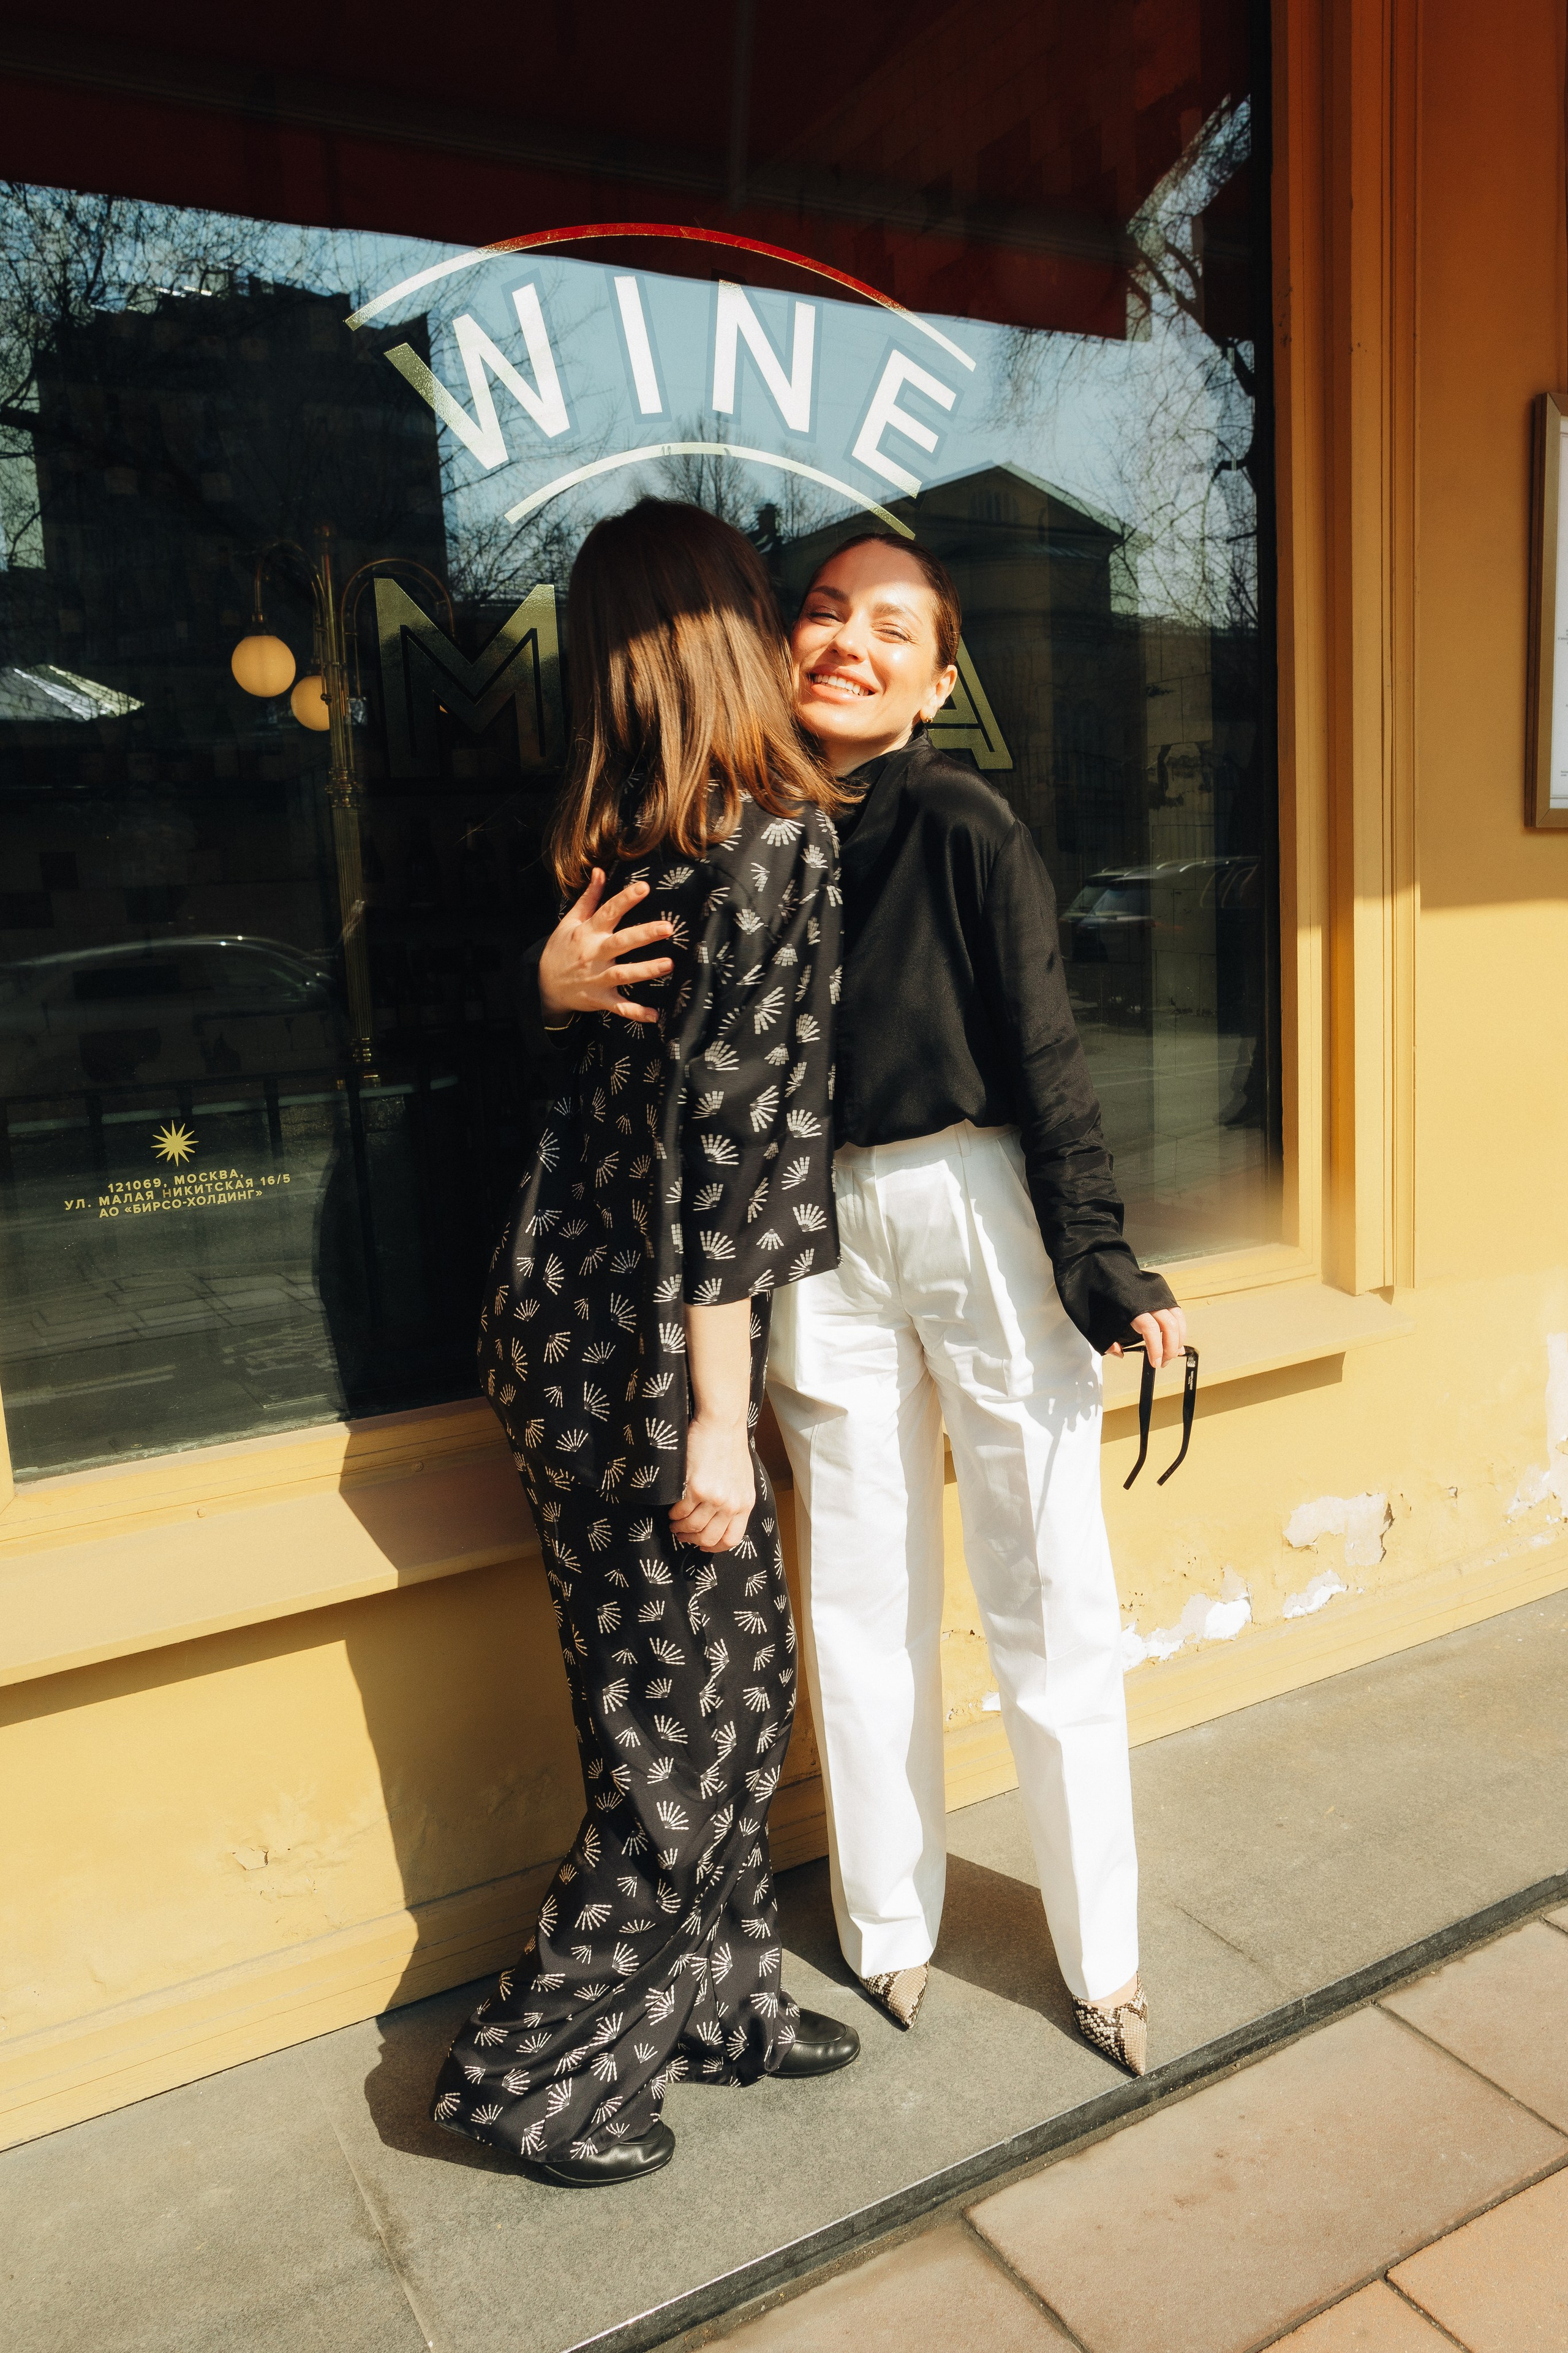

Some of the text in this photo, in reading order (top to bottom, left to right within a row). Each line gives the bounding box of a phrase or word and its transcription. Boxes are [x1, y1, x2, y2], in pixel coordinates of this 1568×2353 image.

[384, 275, 957, 498] WINE
[64, 1173, 291, 1210] УЛ. МАЛАЯ НИКИТСКАЯ 16/5
[108, 1168, 244, 1193] 121069, МОСКВА,
[99, 1189, 263, 1218] АО «БИРСО-ХОЛДИНГ»
